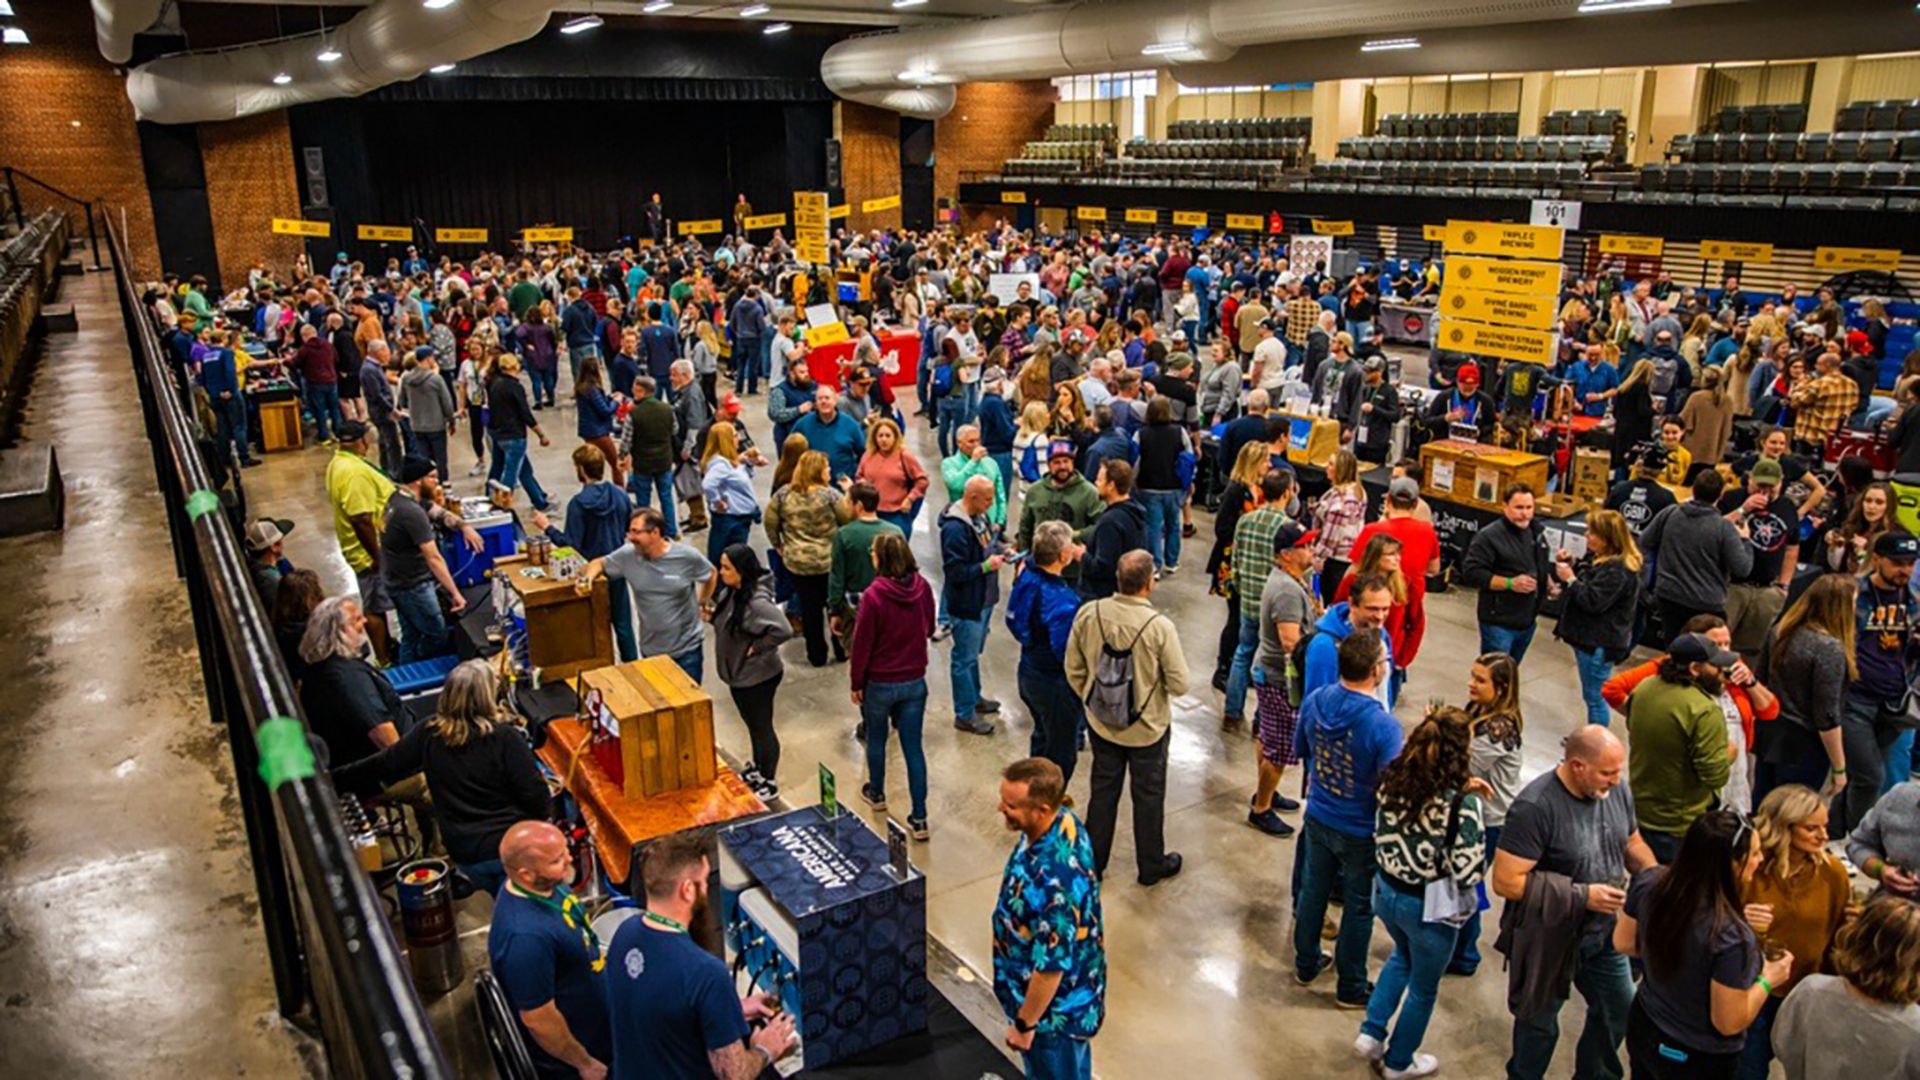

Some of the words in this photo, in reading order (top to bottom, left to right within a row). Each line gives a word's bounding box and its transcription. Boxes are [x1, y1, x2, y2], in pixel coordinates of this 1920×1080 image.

[1545, 206, 1566, 218] 101
[1502, 231, 1528, 239] TRIPLE
[1529, 232, 1535, 240] C
[1500, 240, 1535, 249] BREWING
[1521, 270, 1546, 278] ROBOT
[1497, 276, 1534, 285] BREWERY
[1484, 298, 1507, 307] DIVINE
[1509, 301, 1537, 311] BARREL
[1493, 308, 1527, 318] BREWING
[1477, 331, 1515, 341] SOUTHERN
[1516, 336, 1543, 346] STRAIN
[1474, 339, 1506, 350] BREWING
[1508, 344, 1543, 354] COMPANY
[794, 826, 832, 860] COMPANY
[771, 825, 846, 889] AMERICANA
[830, 861, 855, 881] BEER
